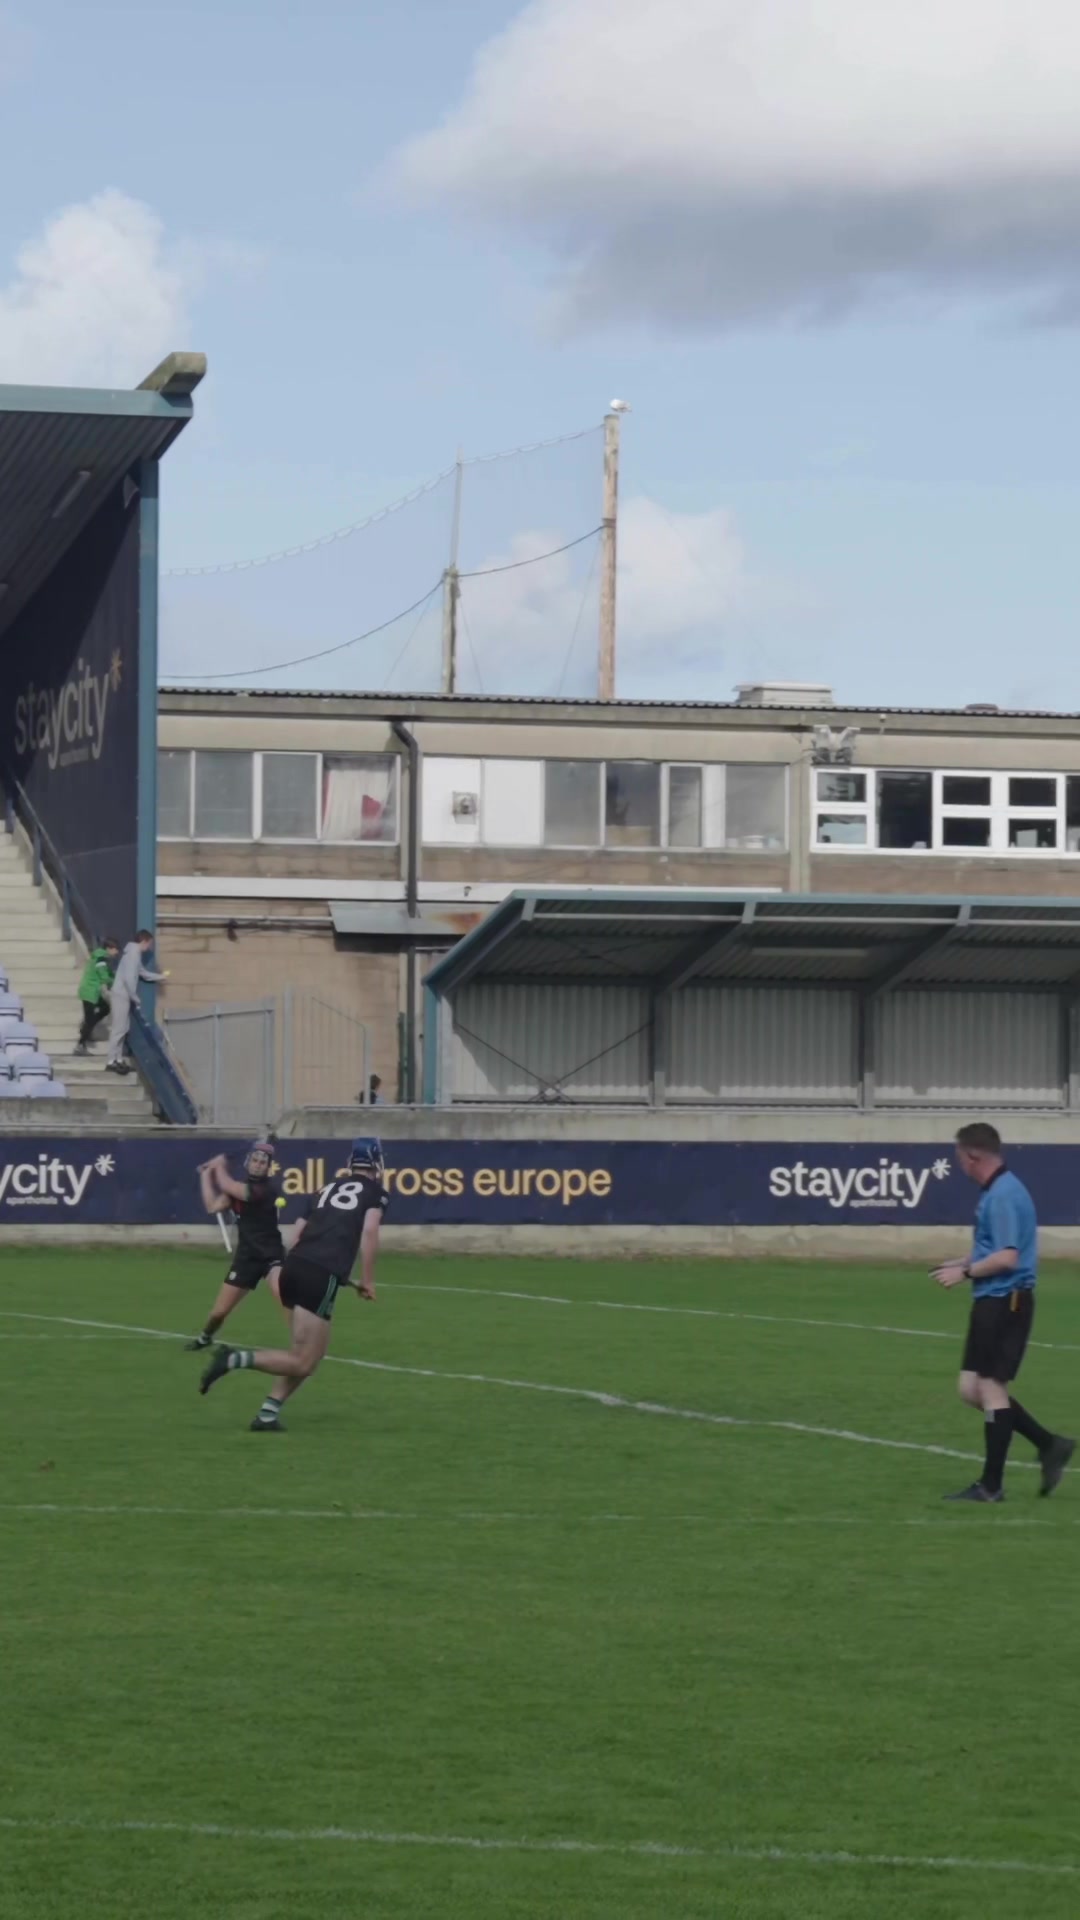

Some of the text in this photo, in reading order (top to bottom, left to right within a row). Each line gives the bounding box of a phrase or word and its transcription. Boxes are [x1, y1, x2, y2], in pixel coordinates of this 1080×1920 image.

[15, 656, 109, 770] staycity
[281, 1157, 612, 1205] all ross europe
[316, 1181, 364, 1211] 18
[769, 1157, 931, 1208] staycity
